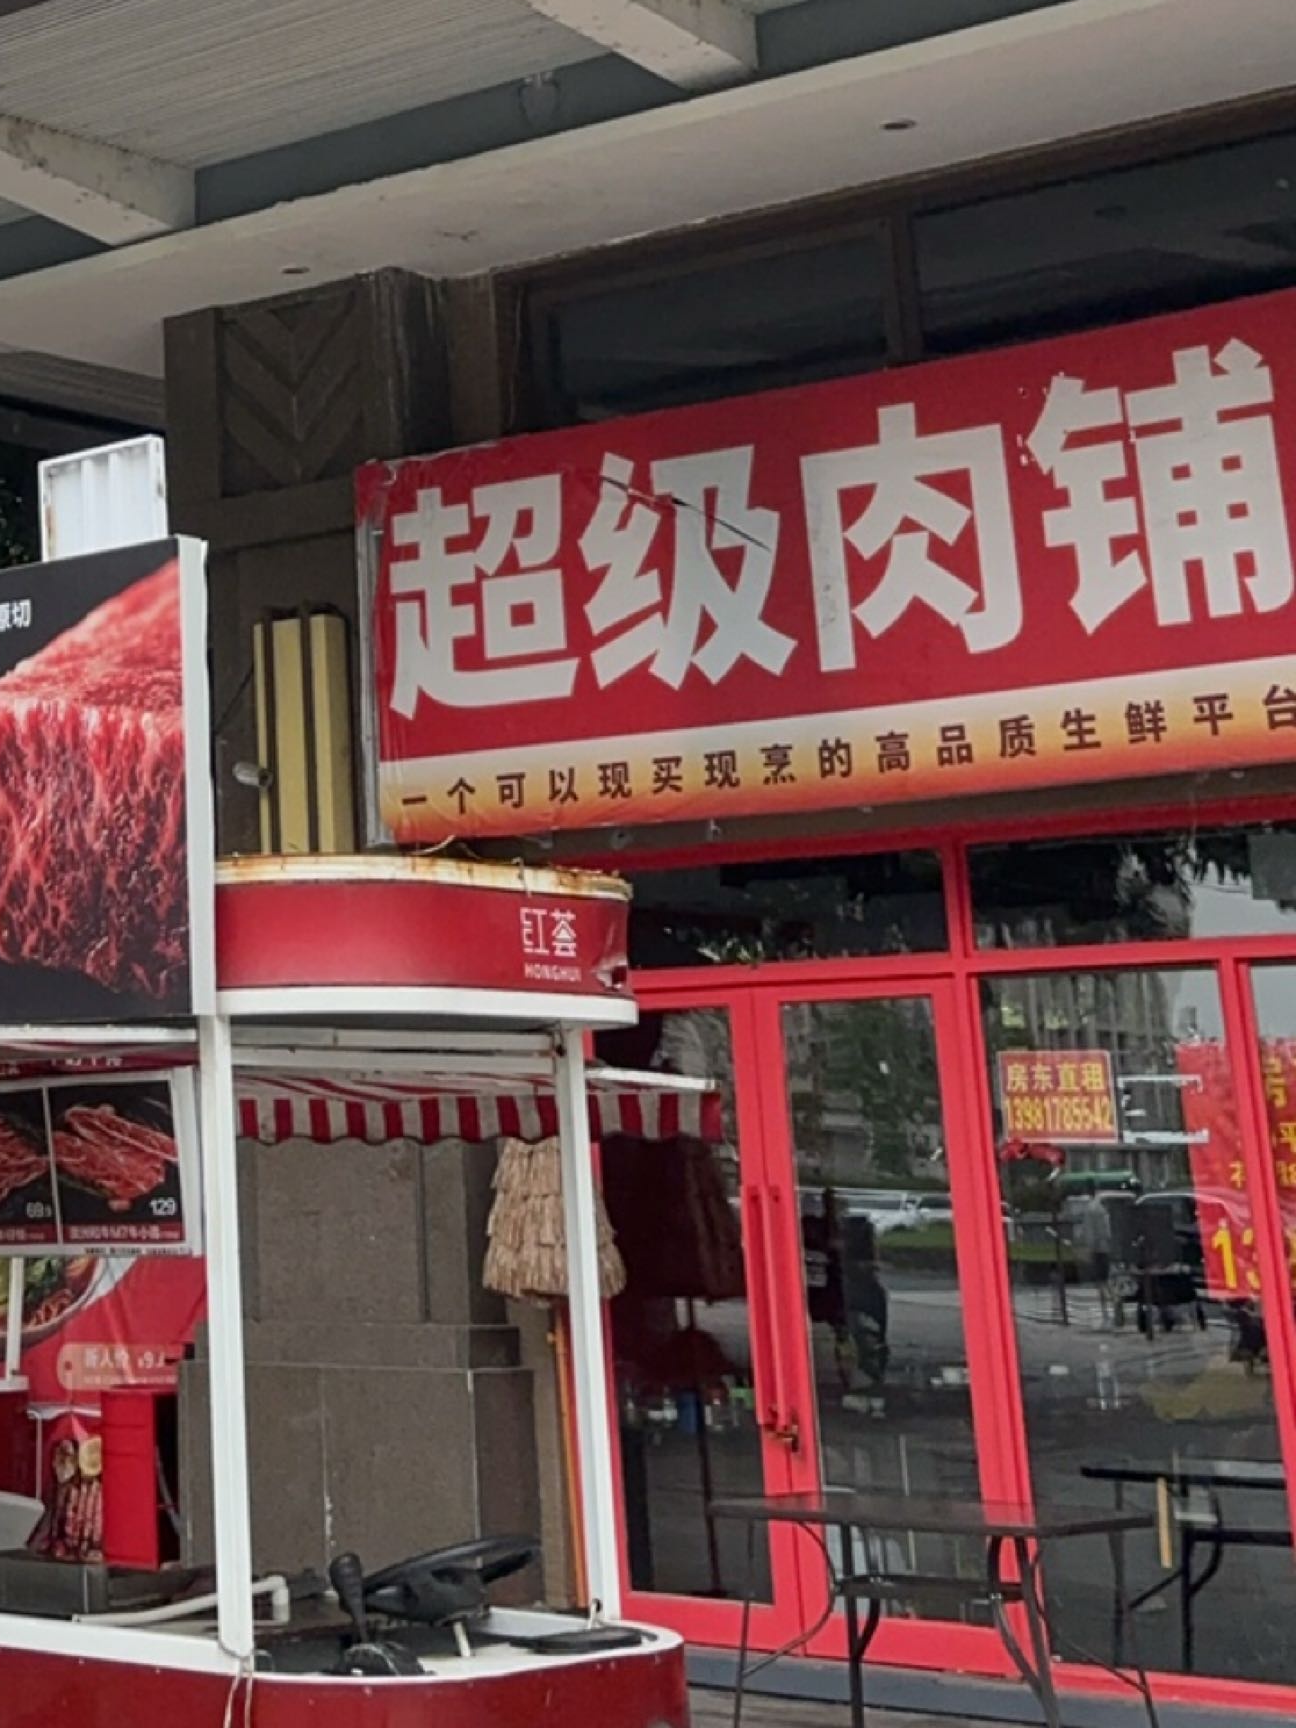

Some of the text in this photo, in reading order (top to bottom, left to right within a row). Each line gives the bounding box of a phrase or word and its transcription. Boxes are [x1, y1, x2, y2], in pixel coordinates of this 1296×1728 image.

[389, 337, 1296, 720] 超级肉铺
[401, 683, 1296, 815] 一个可以现买现烹的高品质生鲜平台
[1006, 1062, 1105, 1092] 房东直租
